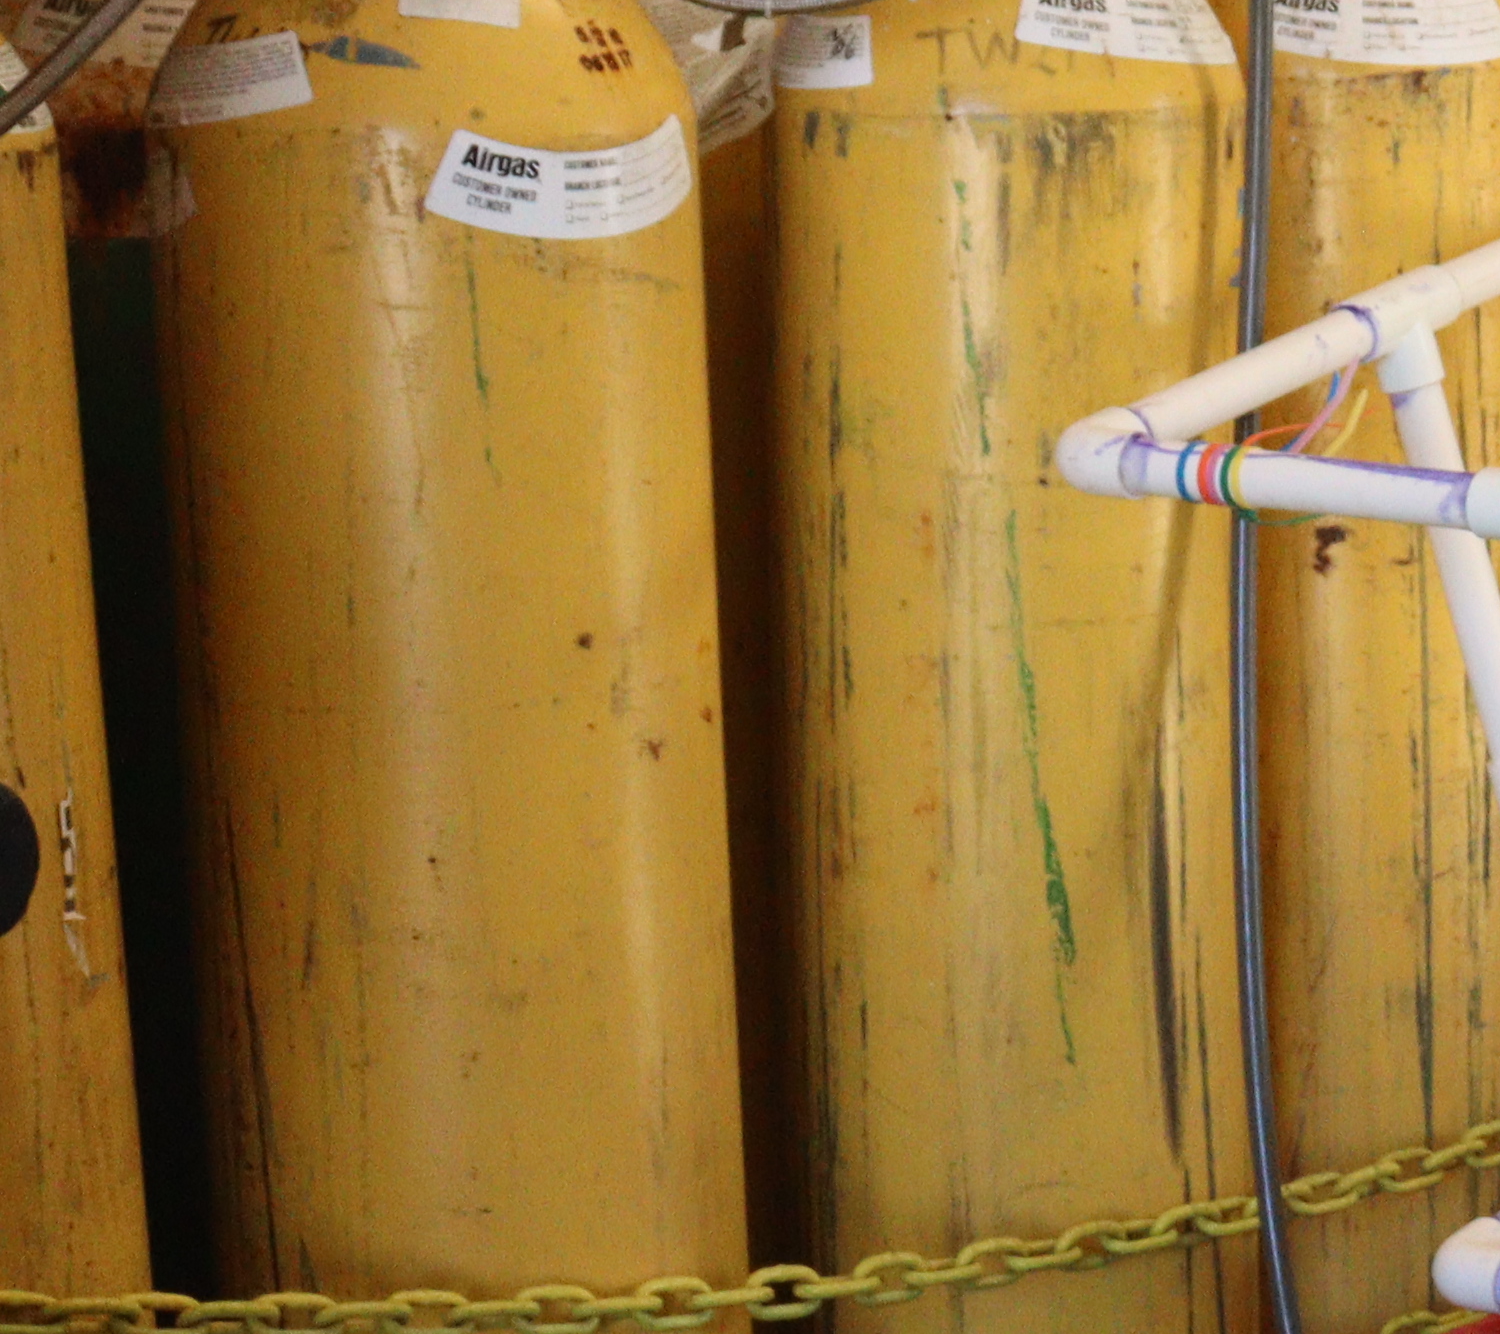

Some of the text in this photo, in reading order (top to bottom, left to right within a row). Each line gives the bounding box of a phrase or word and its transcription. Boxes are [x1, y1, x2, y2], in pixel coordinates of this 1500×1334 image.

[462, 144, 541, 181] Airgas
[452, 172, 538, 203] CUSTOMER OWNED
